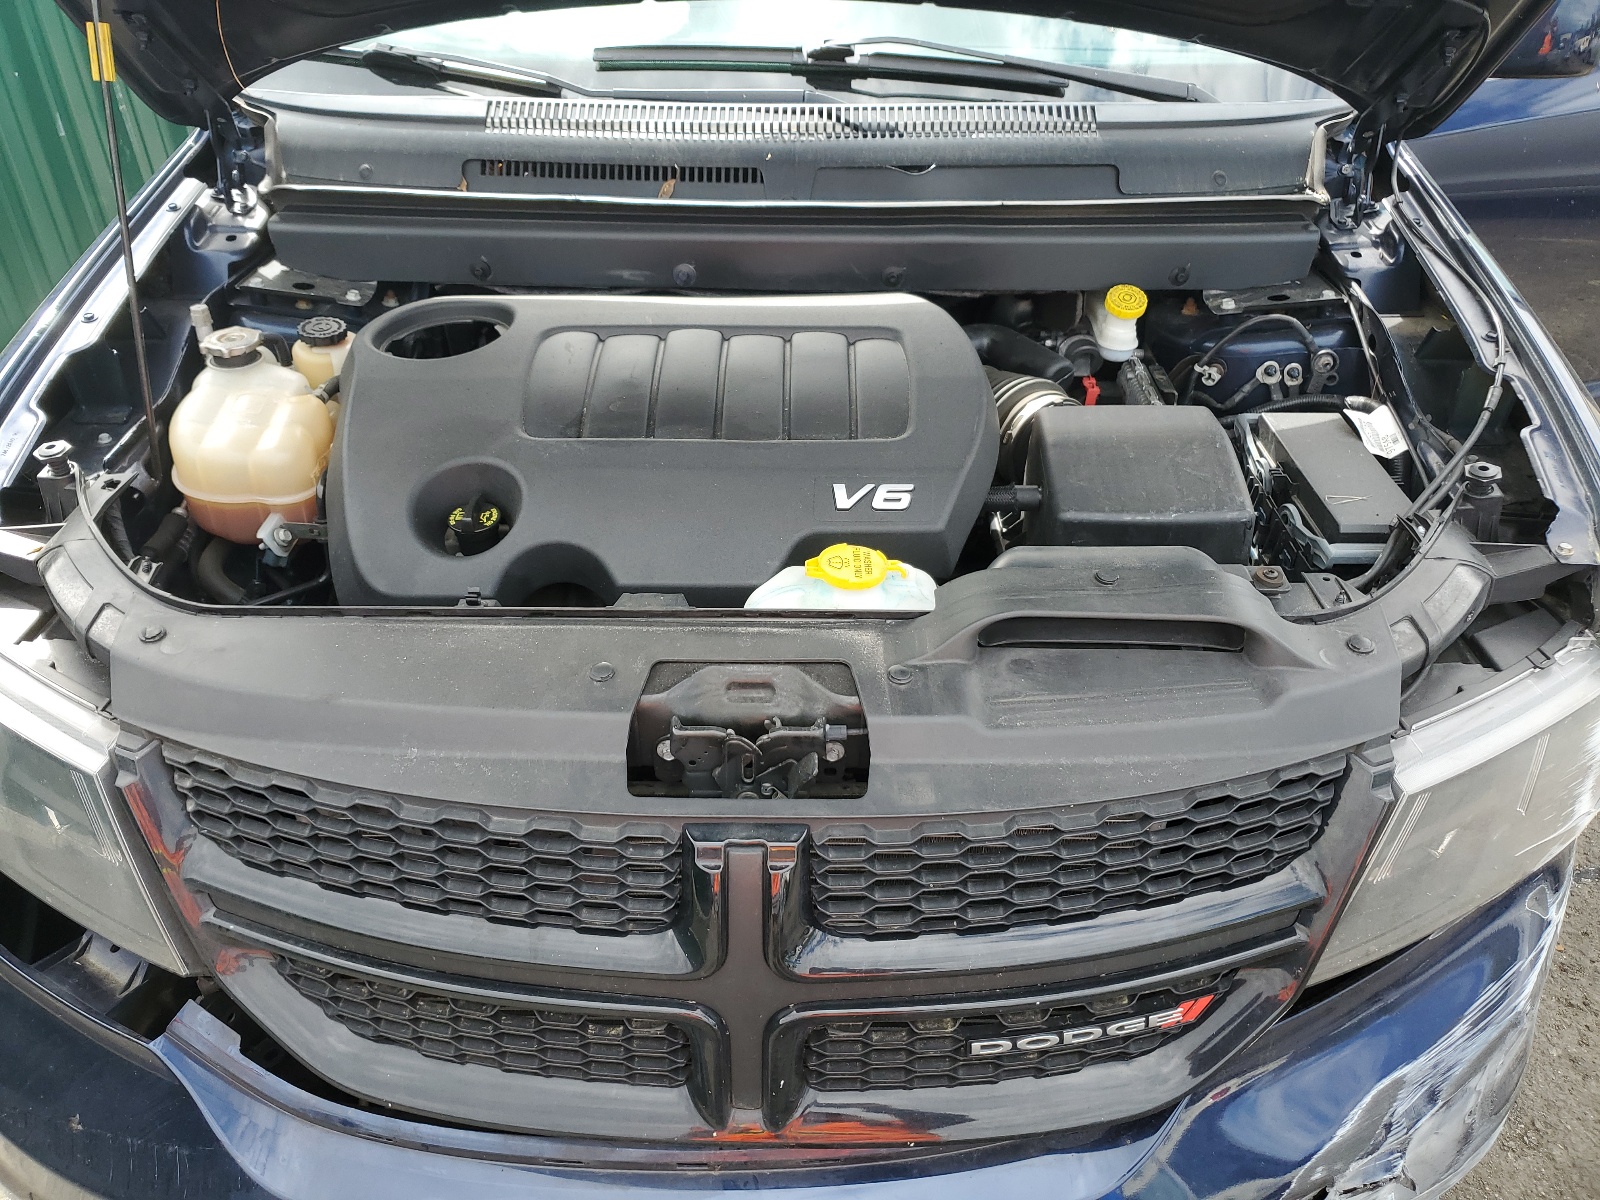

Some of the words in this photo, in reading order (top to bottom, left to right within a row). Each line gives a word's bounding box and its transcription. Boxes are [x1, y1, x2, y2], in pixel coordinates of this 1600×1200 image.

[832, 483, 915, 512] V6
[852, 547, 861, 563] FLUID
[862, 550, 873, 575] WASHER
[853, 564, 863, 579] ONLY
[970, 1007, 1184, 1056] DODGE
